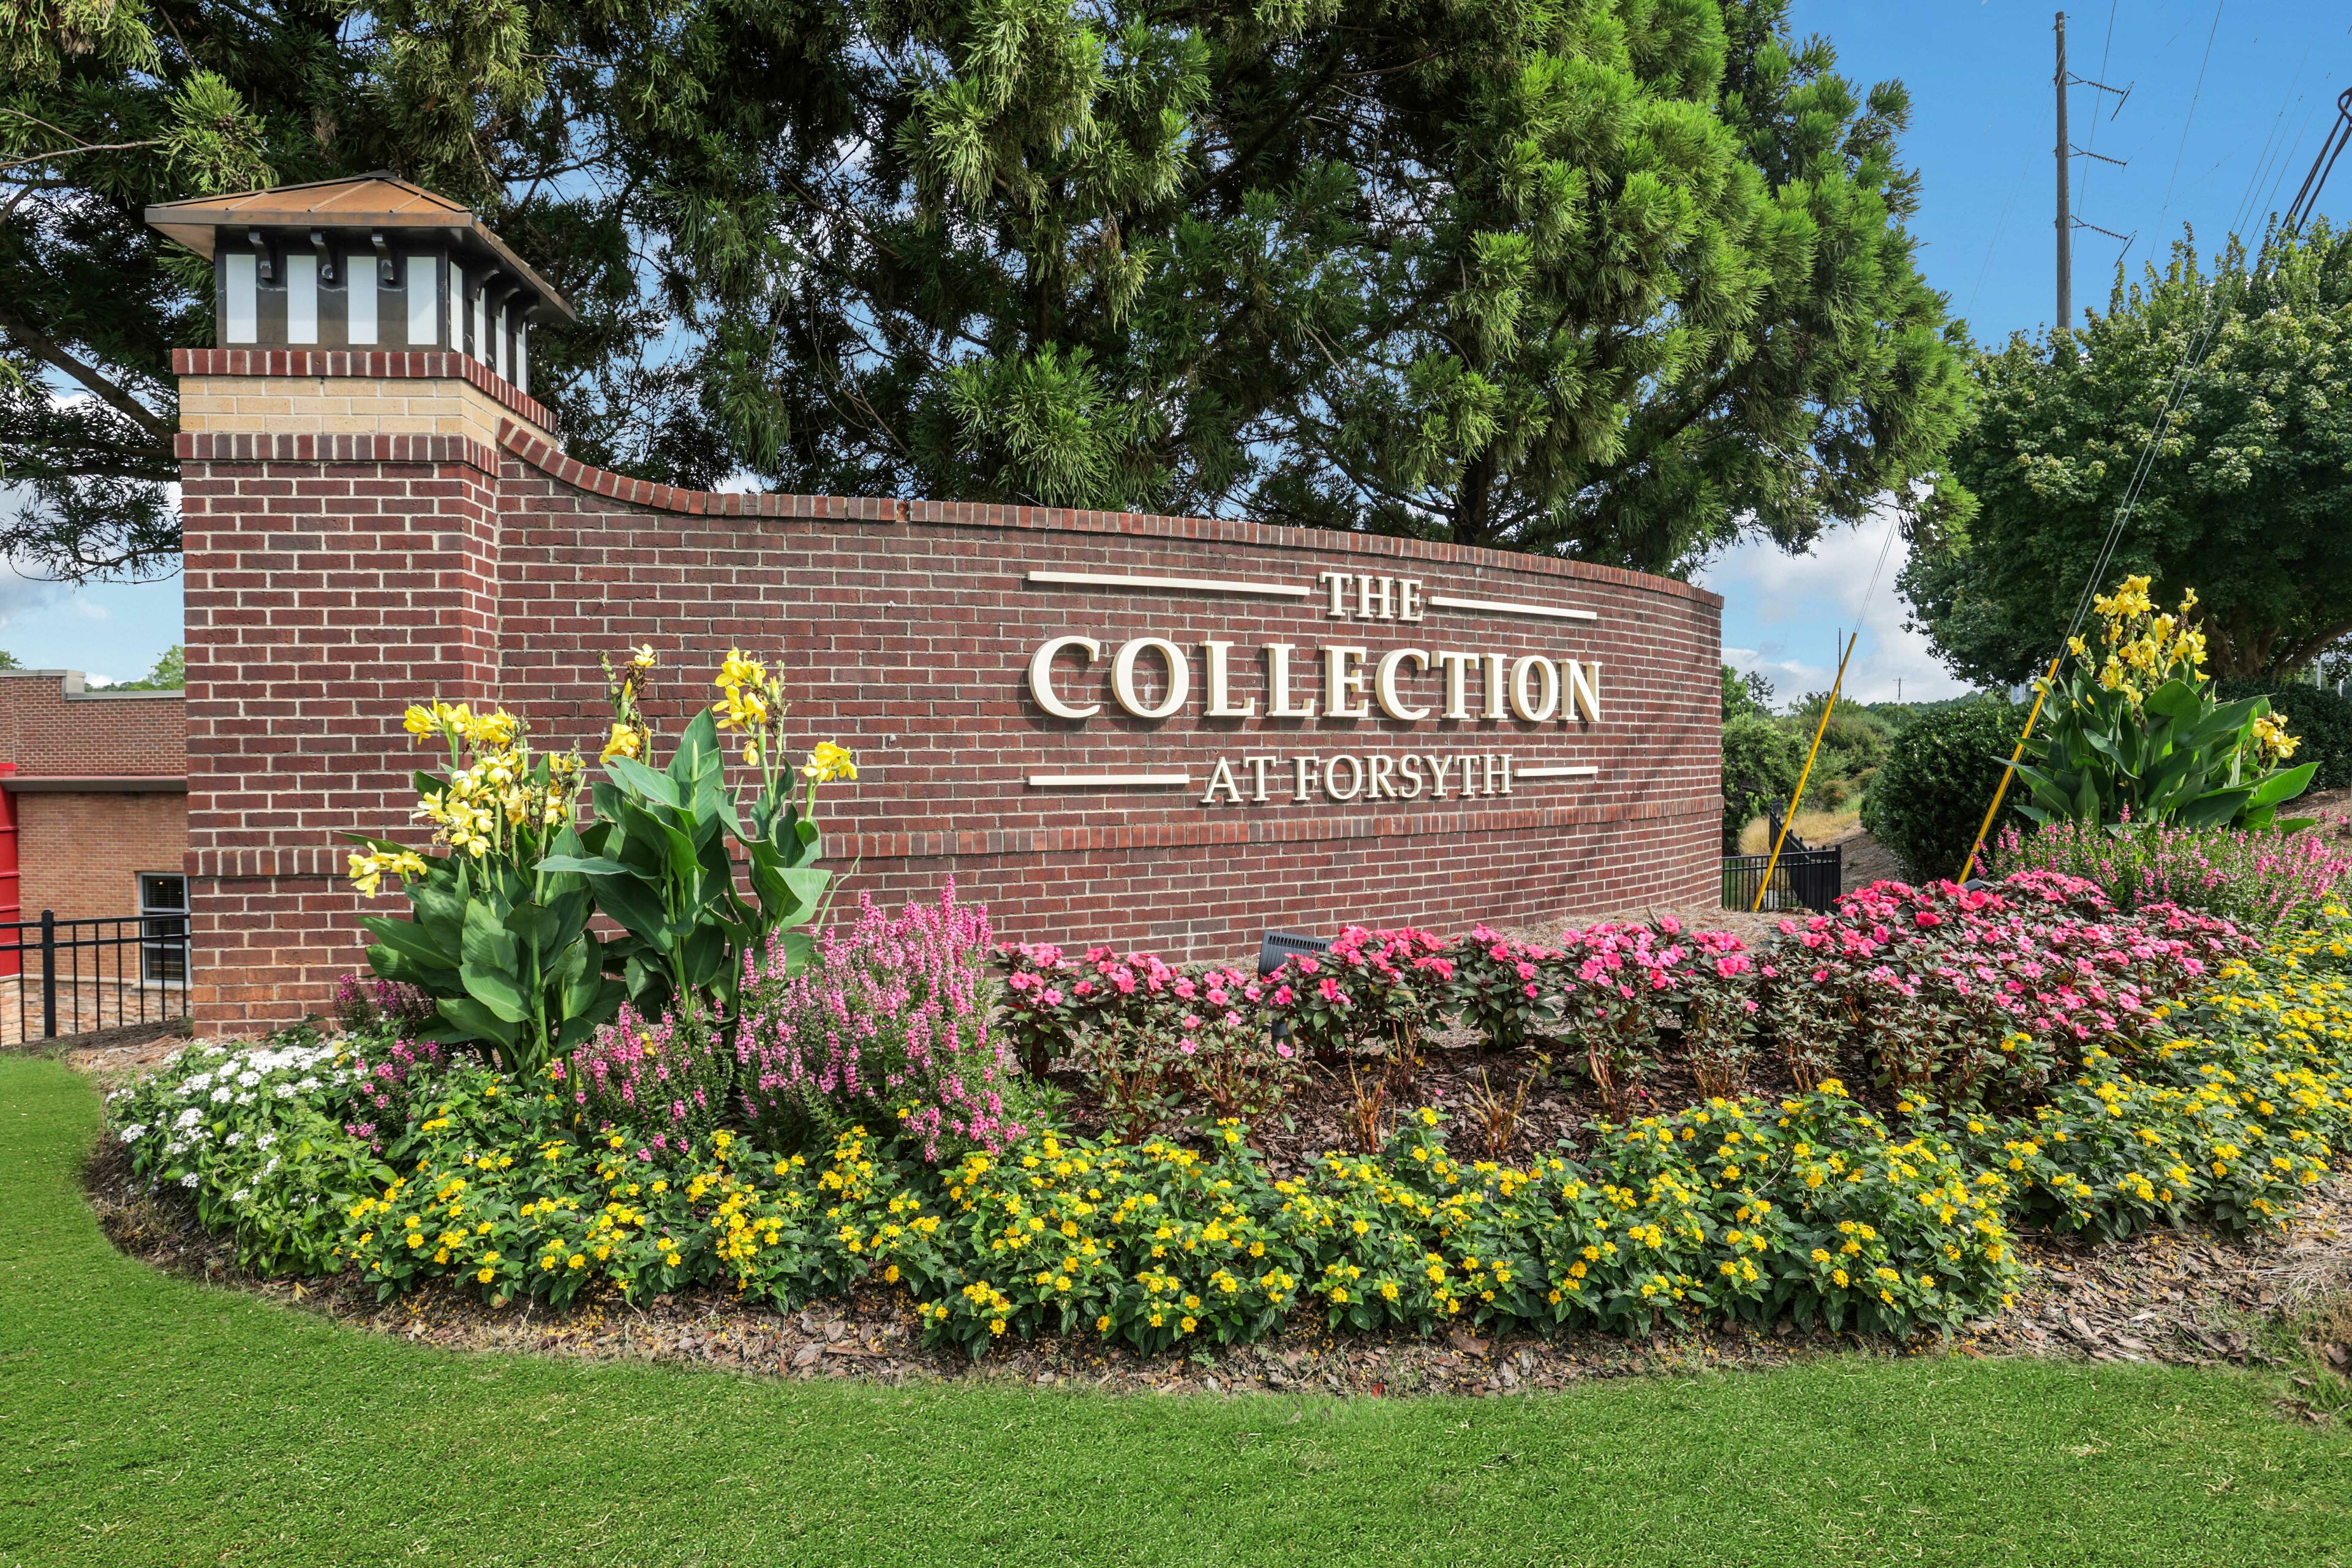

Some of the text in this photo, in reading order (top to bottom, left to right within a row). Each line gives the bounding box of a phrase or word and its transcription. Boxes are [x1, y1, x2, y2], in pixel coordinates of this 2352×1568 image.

[1319, 571, 1423, 622] THE
[1028, 635, 1602, 723] COLLECTION
[1200, 753, 1513, 803] AT FORSYTH
